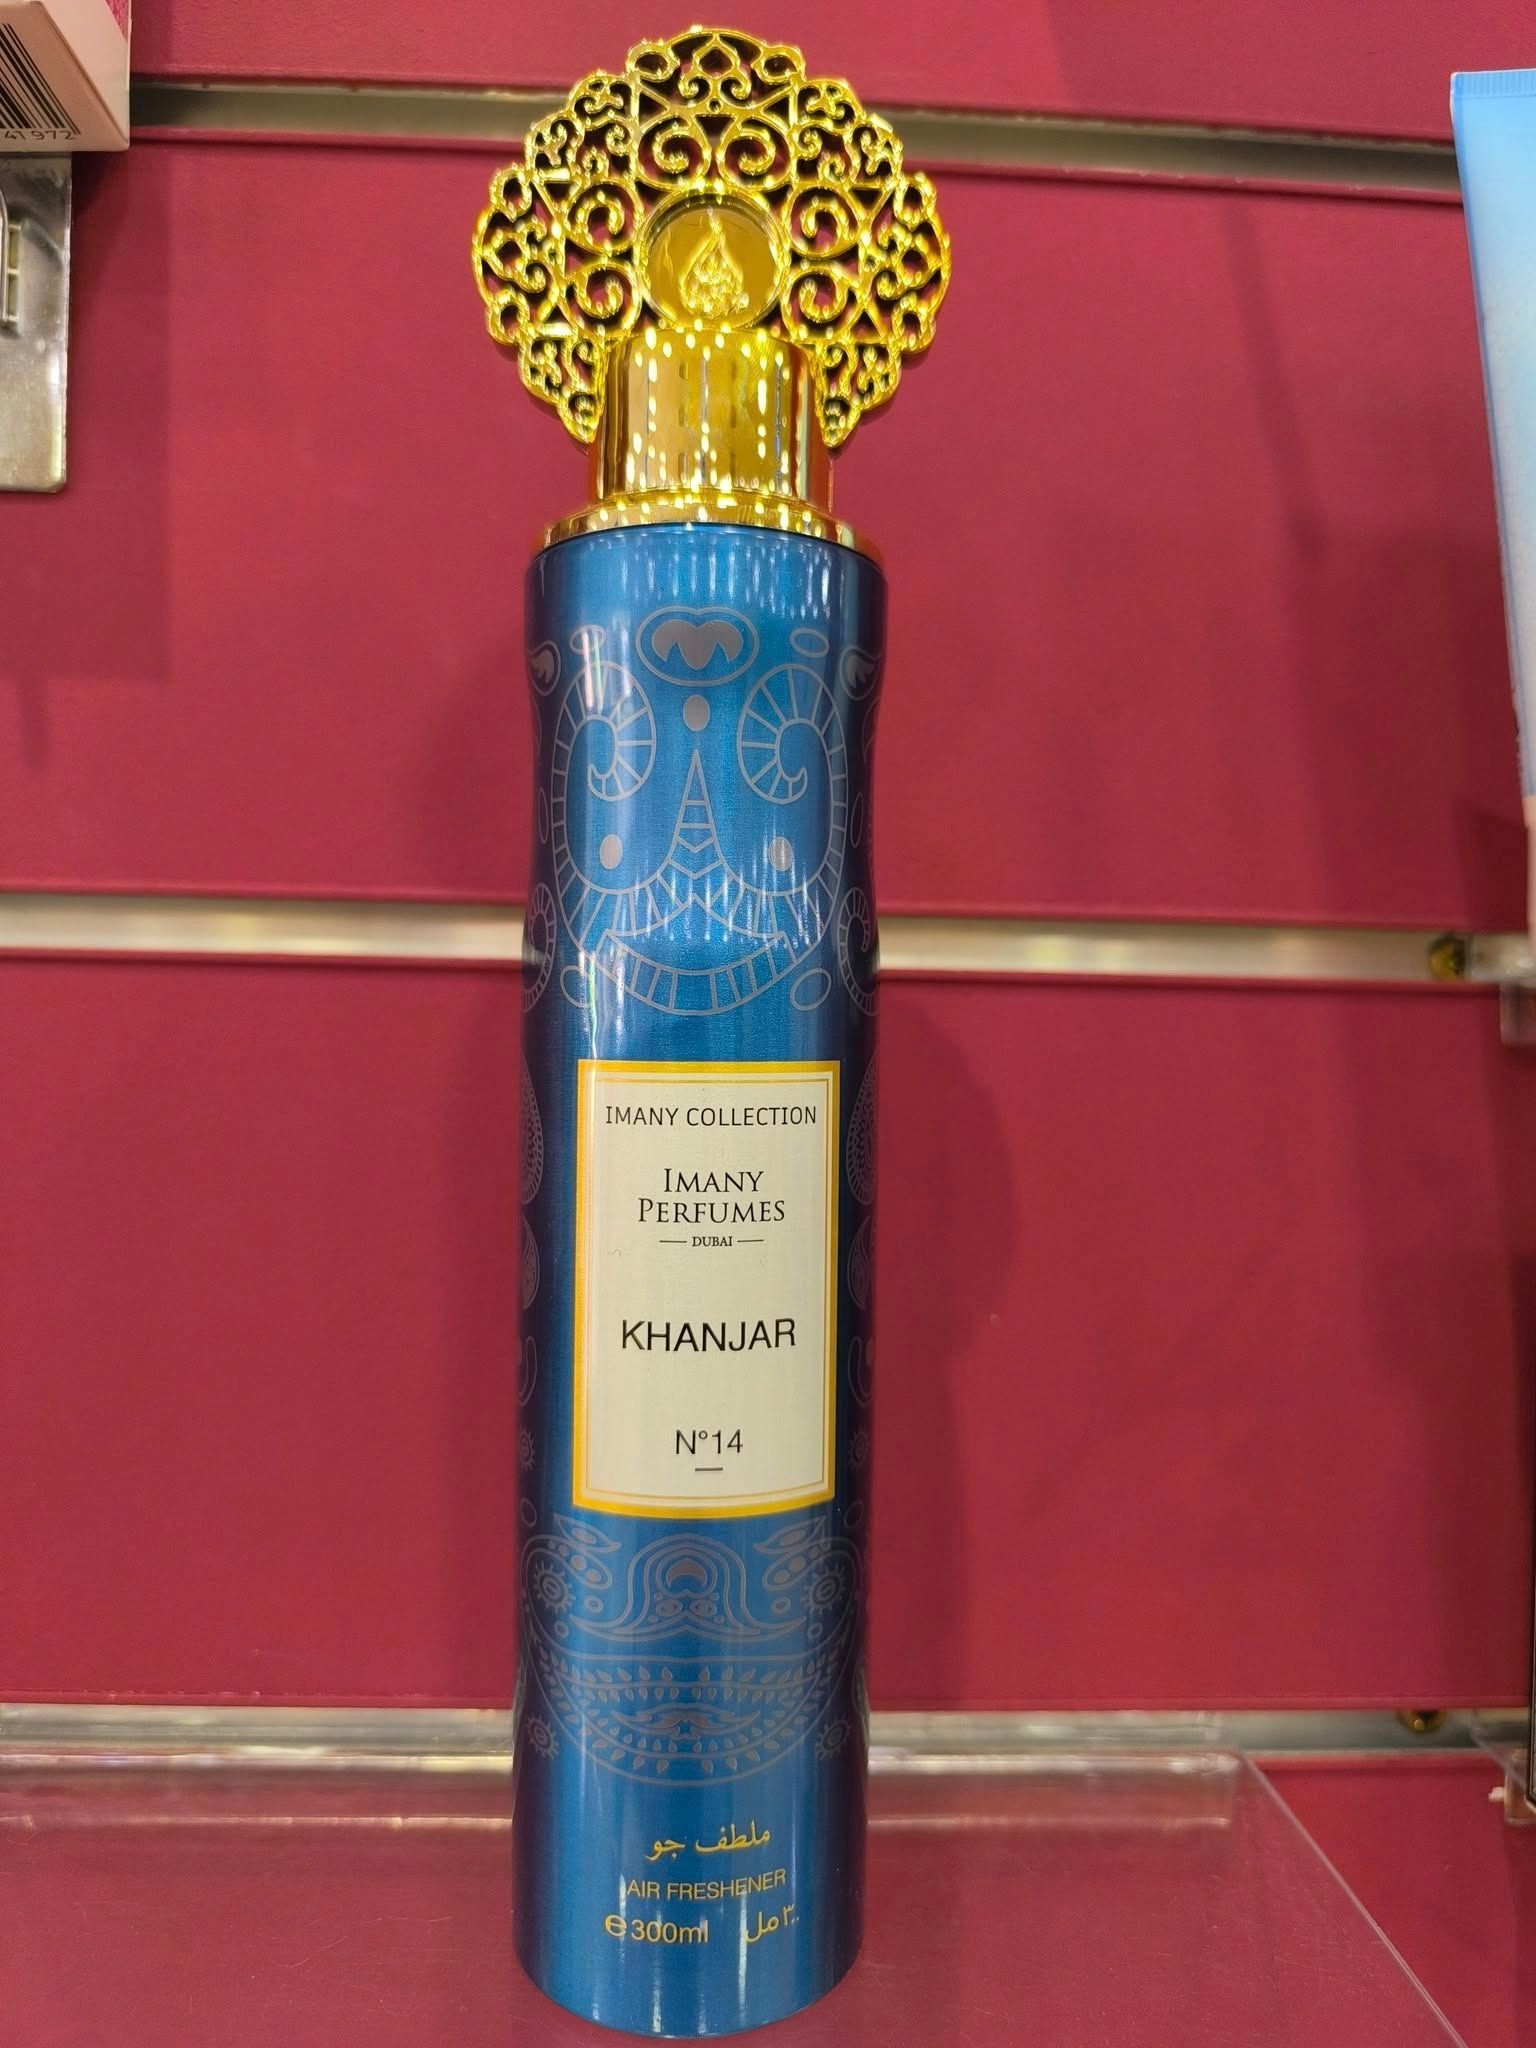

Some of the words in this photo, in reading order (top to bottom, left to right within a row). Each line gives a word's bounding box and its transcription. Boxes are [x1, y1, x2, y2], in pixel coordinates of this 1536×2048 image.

[605, 1105, 679, 1127] IMANY
[686, 1105, 817, 1127] COLLECTION
[663, 1167, 764, 1193] IMANY
[637, 1197, 785, 1224] PERFUMES
[691, 1236, 733, 1247] DUBAI
[621, 1317, 796, 1352] KHANJAR
[675, 1428, 743, 1455] N°14
[695, 1819, 771, 1853] ملطف
[645, 1839, 686, 1861] جو
[626, 1879, 661, 1899] AIR
[667, 1868, 786, 1900] FRESHENER
